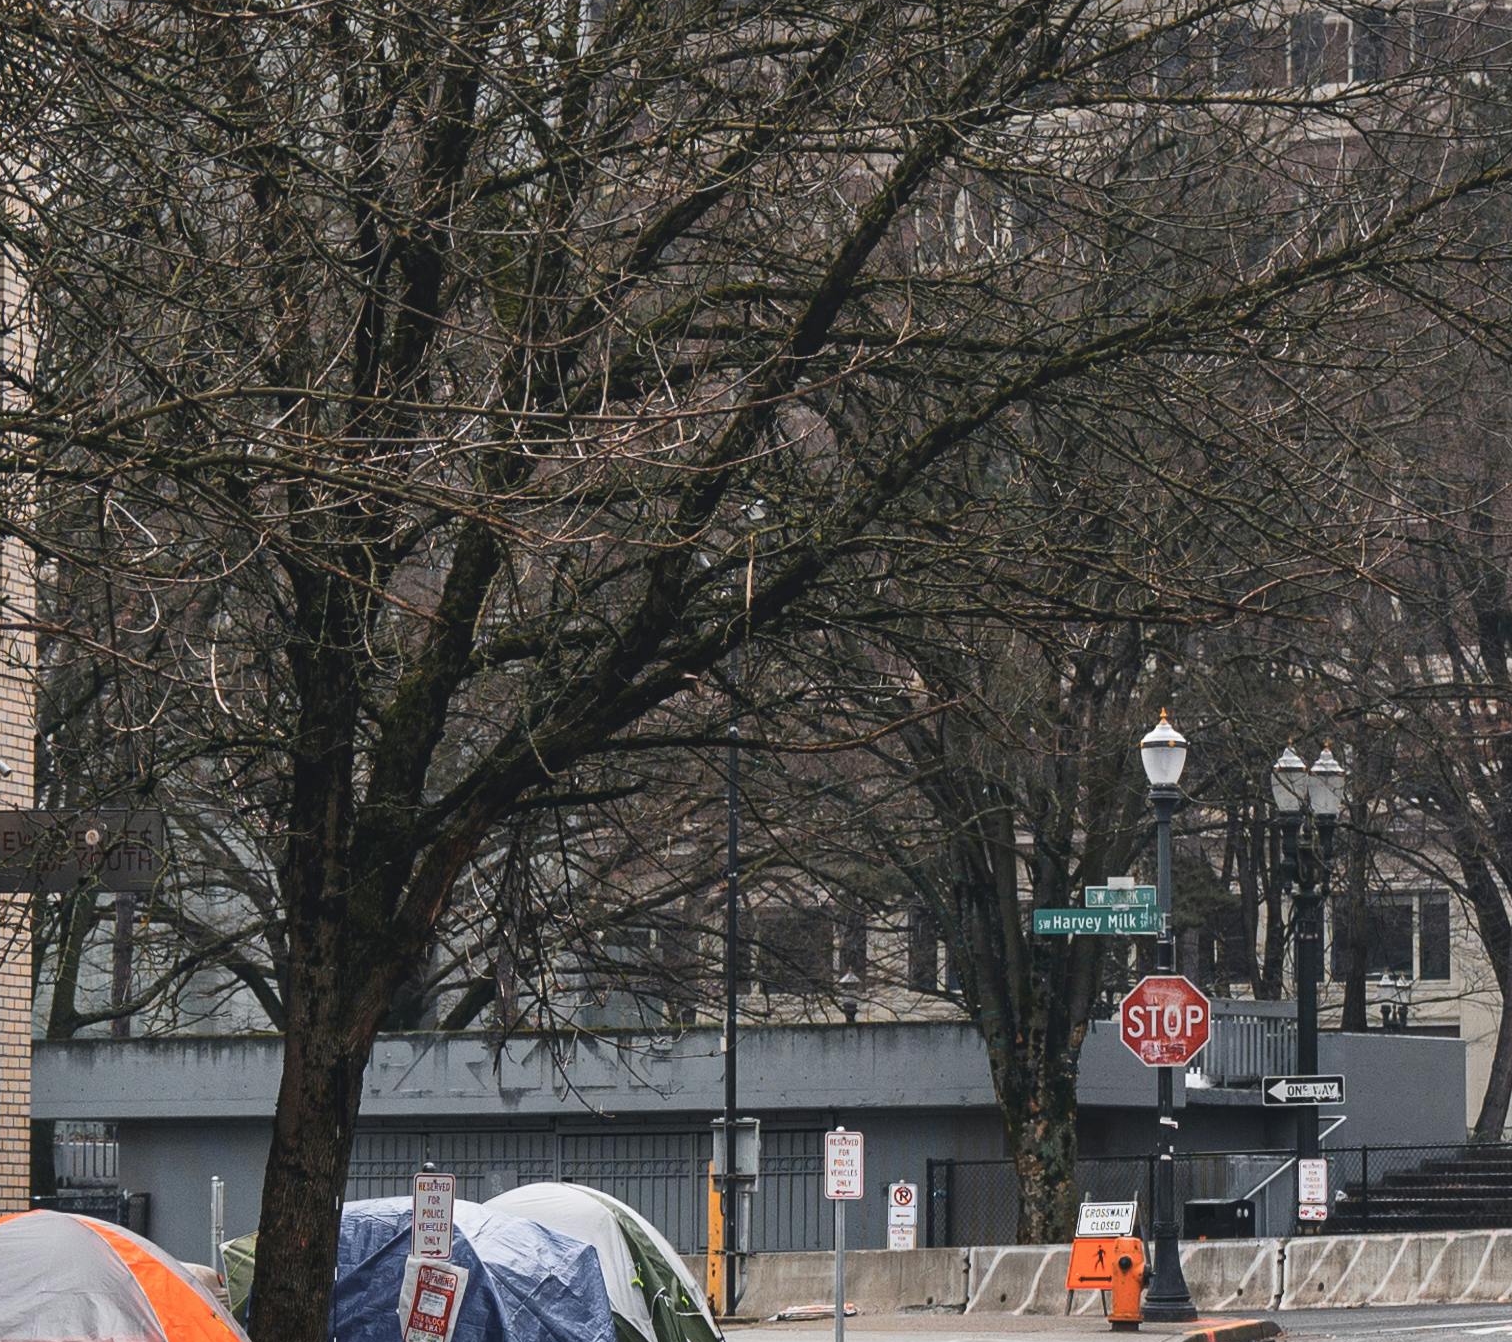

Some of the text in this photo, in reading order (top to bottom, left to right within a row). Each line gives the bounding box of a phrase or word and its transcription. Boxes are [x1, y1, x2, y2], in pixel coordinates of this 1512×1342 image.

[1091, 891, 1105, 904] SW
[1038, 920, 1051, 930] SW
[1053, 916, 1101, 932] Harvey
[1108, 914, 1136, 929] Milk
[1127, 1005, 1204, 1038] STOP
[1313, 1084, 1336, 1096] WAY
[834, 1159, 854, 1167] POLICE
[418, 1182, 451, 1192] RESERVED
[428, 1195, 441, 1204] FOR
[422, 1209, 444, 1219] POLICE
[1085, 1208, 1130, 1219] CROSSWALK
[1091, 1221, 1121, 1231] CLOSED
[424, 1236, 441, 1245] ONLY
